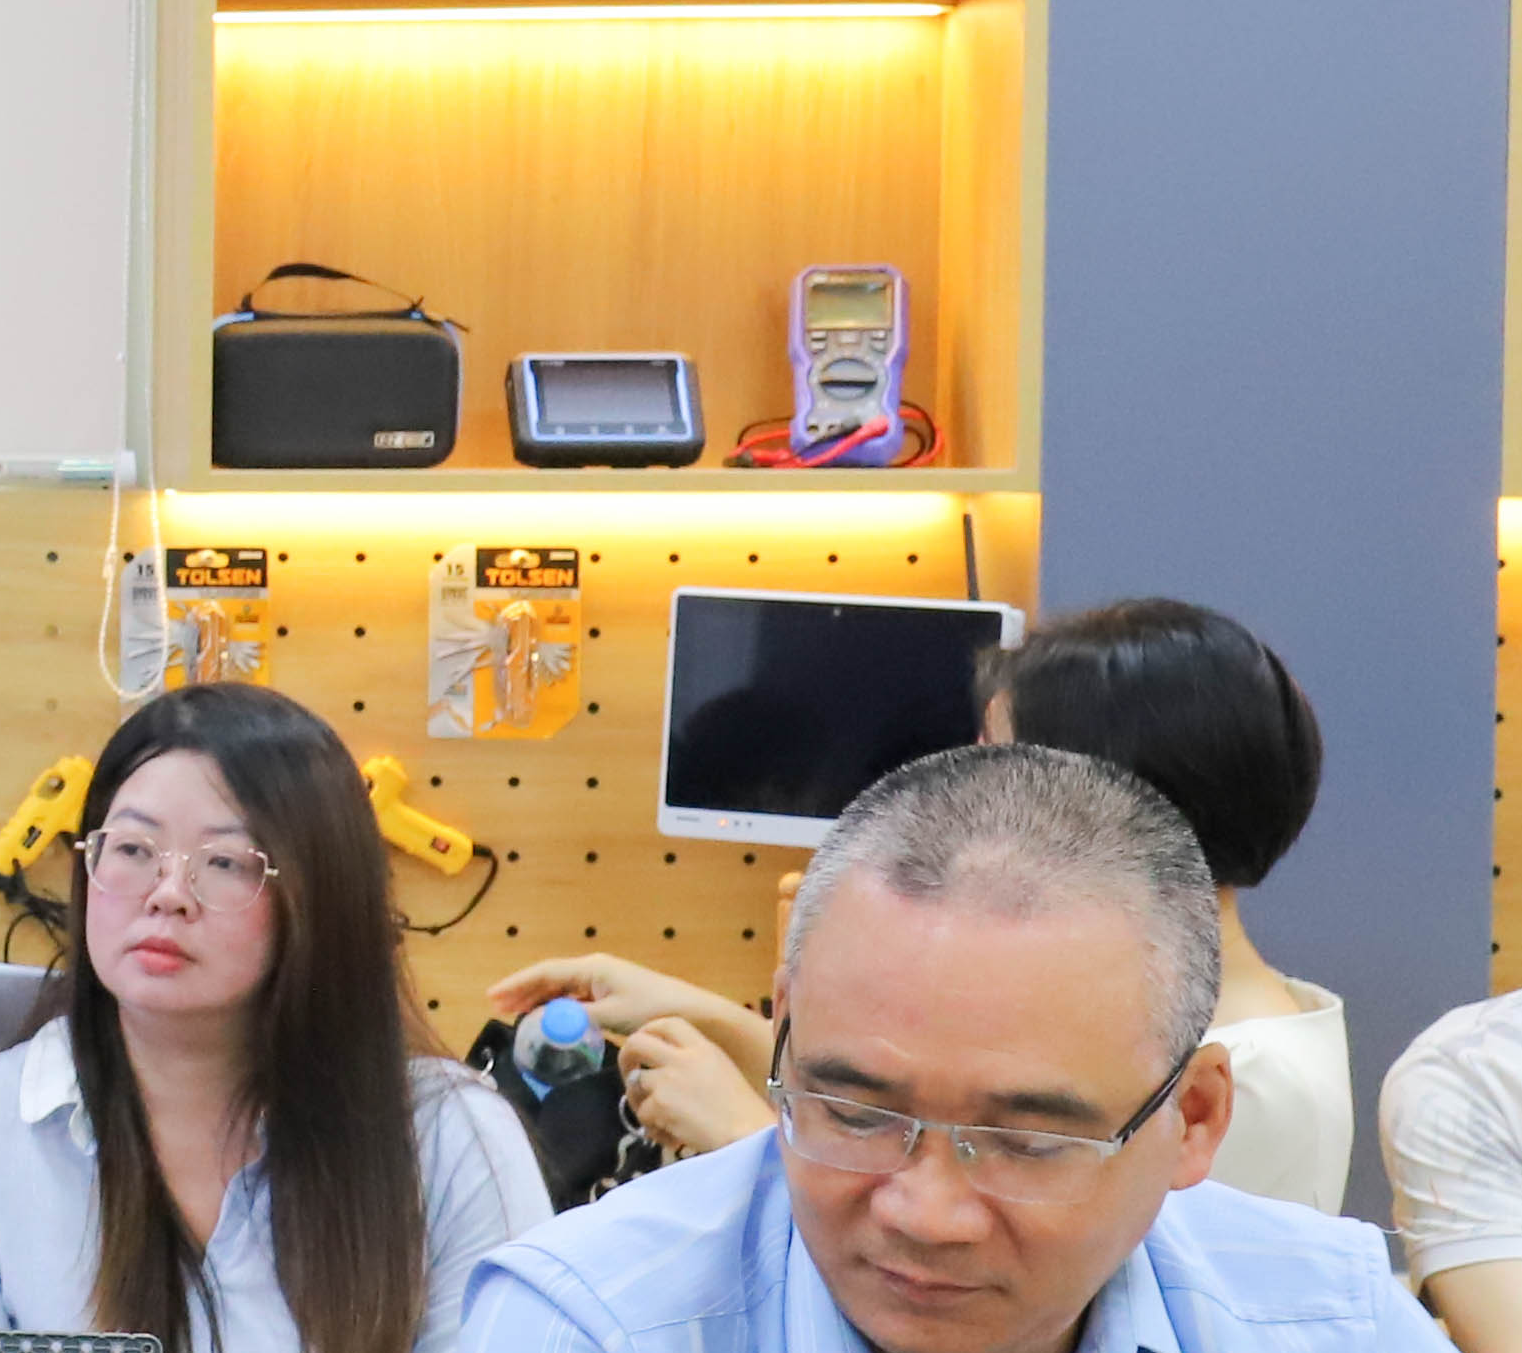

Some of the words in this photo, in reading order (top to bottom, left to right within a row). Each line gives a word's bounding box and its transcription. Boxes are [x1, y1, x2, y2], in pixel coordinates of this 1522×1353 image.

[137, 563, 154, 577] 15
[176, 568, 262, 586] TOLSEN
[446, 563, 464, 576] 15
[485, 567, 574, 586] TOLSEN
